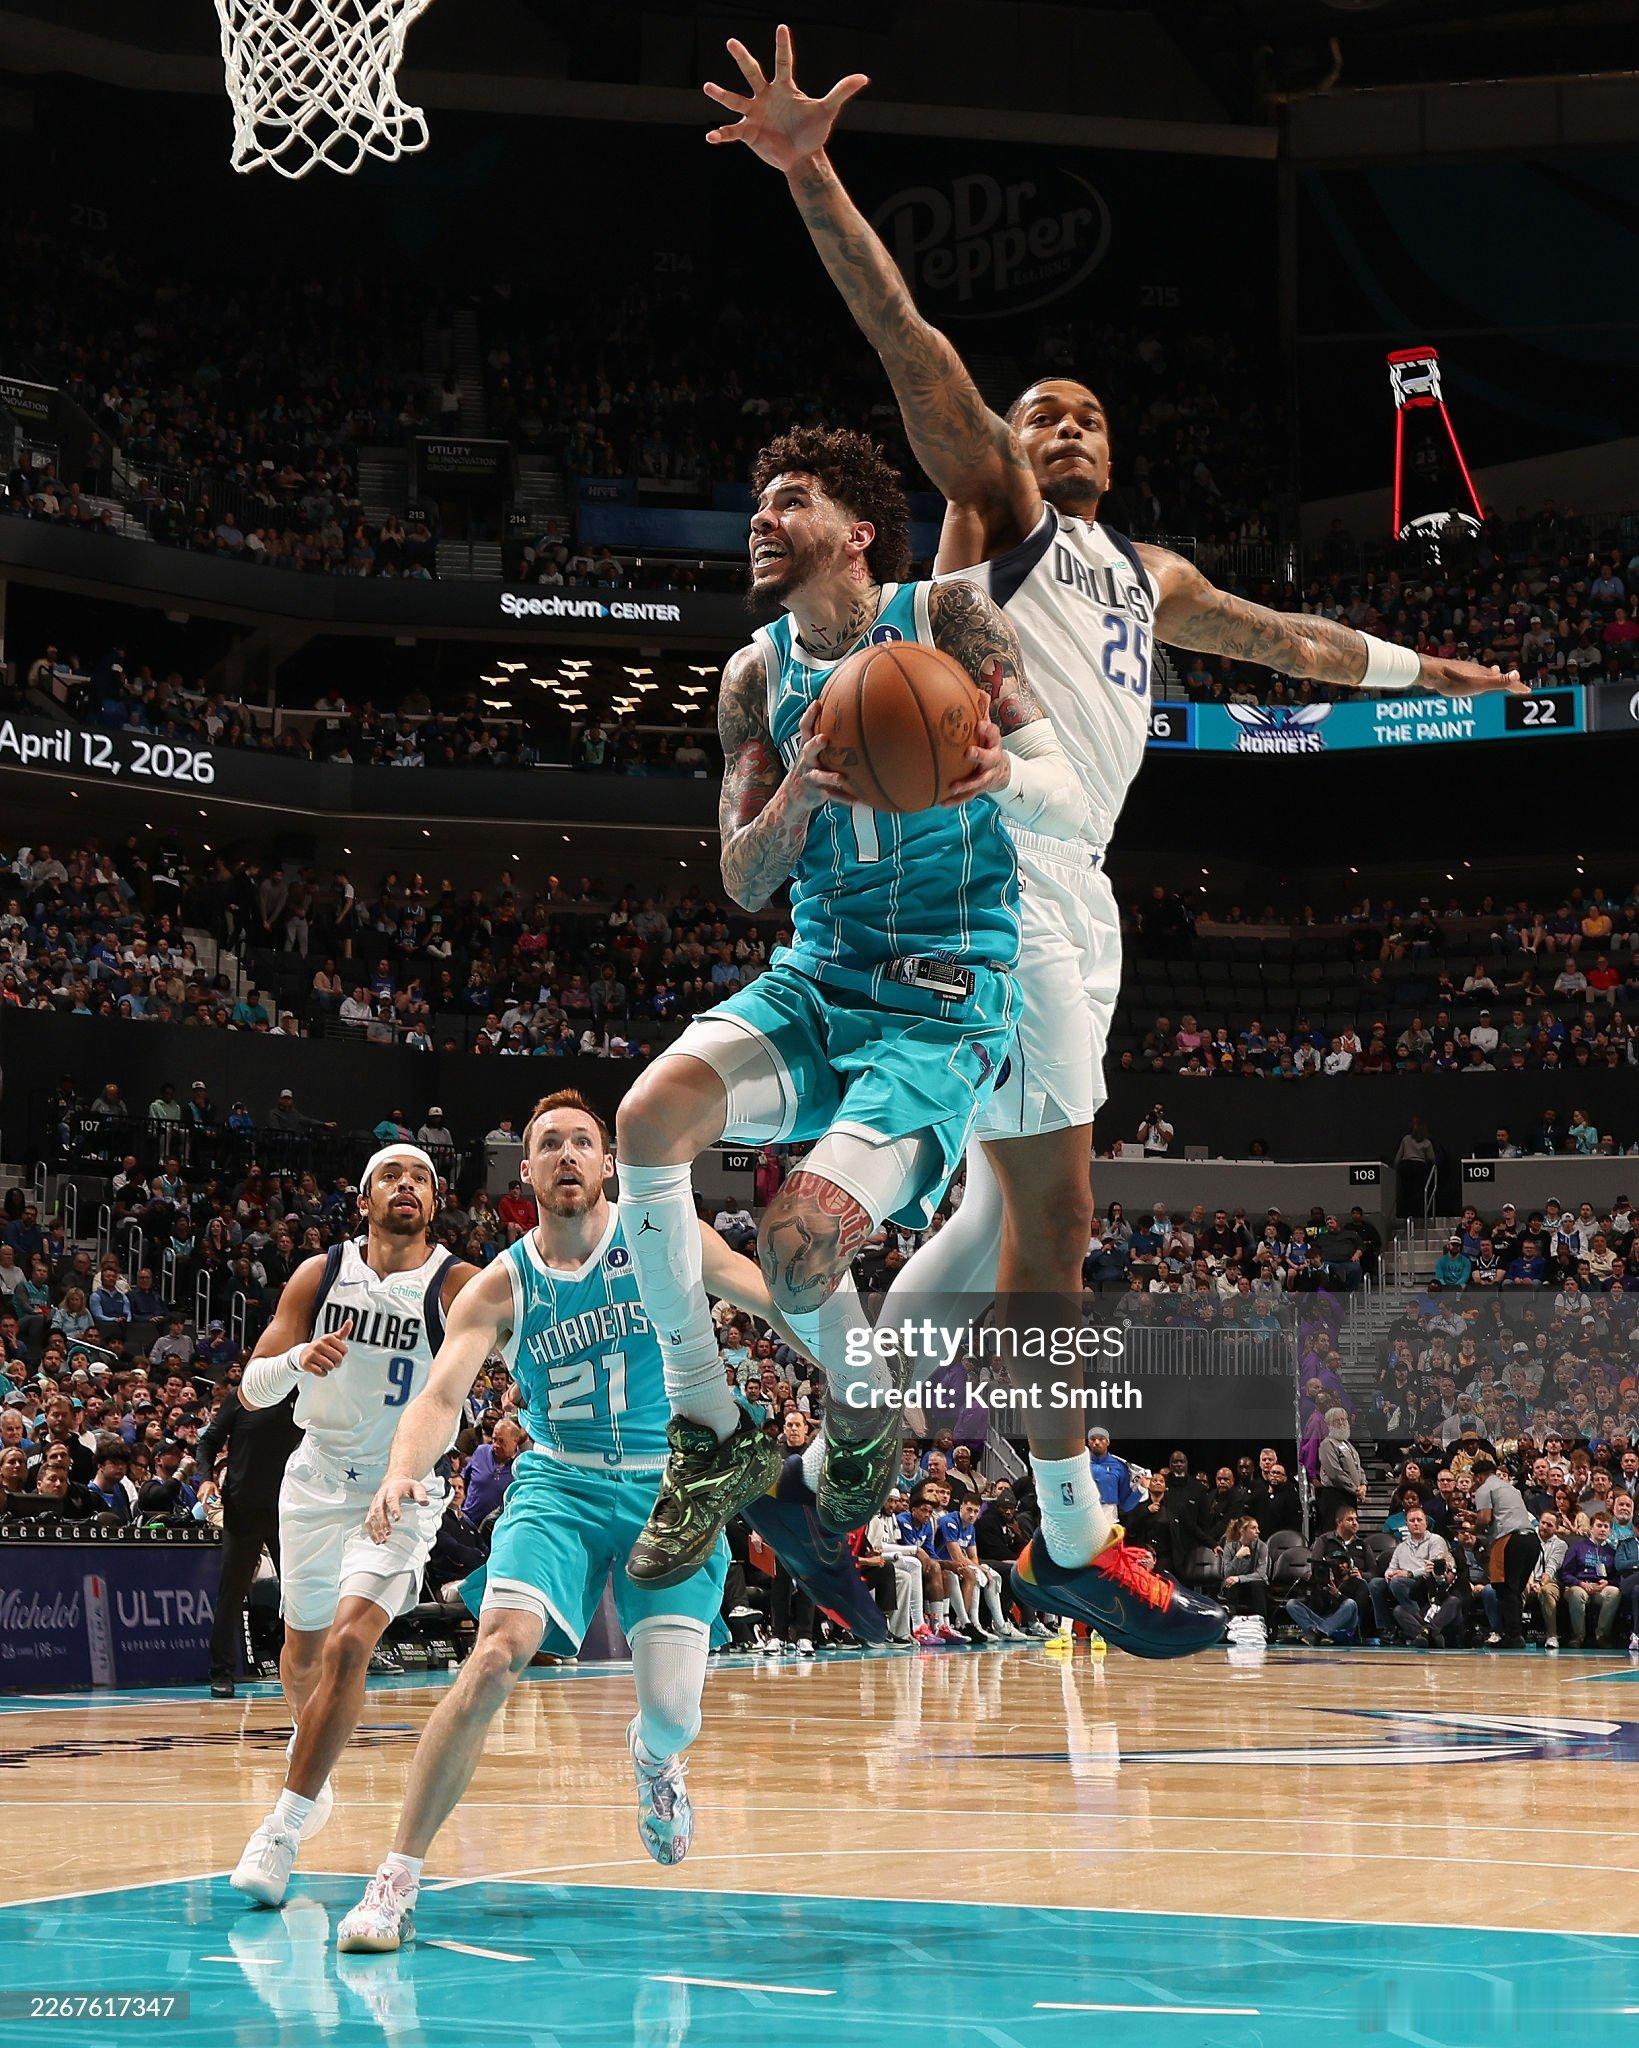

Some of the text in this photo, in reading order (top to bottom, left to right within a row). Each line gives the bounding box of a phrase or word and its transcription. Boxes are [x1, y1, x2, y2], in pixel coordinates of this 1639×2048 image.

[952, 174, 1036, 241] Dr
[872, 185, 1092, 302] Pepper
[1140, 285, 1180, 306] 215
[426, 444, 471, 455] UTILITY
[409, 511, 425, 519] 213
[509, 514, 526, 524] 214
[1053, 541, 1149, 624] DALLS
[500, 592, 681, 622] Spectrum CENTER
[1102, 613, 1148, 697] 25
[1375, 696, 1473, 721] POINTS IN
[1522, 700, 1557, 726] 22
[1239, 732, 1321, 754] HORNETS
[1373, 719, 1476, 744] THE PAINT
[0, 719, 215, 784] April 12, 2026
[79, 1120, 100, 1131] 107
[727, 1156, 749, 1167] 107
[1467, 1166, 1490, 1178] 109
[1353, 1169, 1376, 1181] 108
[391, 1286, 423, 1299] chime
[526, 1301, 650, 1364] HORNETS
[384, 1356, 414, 1406] 9
[547, 1351, 629, 1421] 21
[116, 1589, 215, 1628] ULTRA
